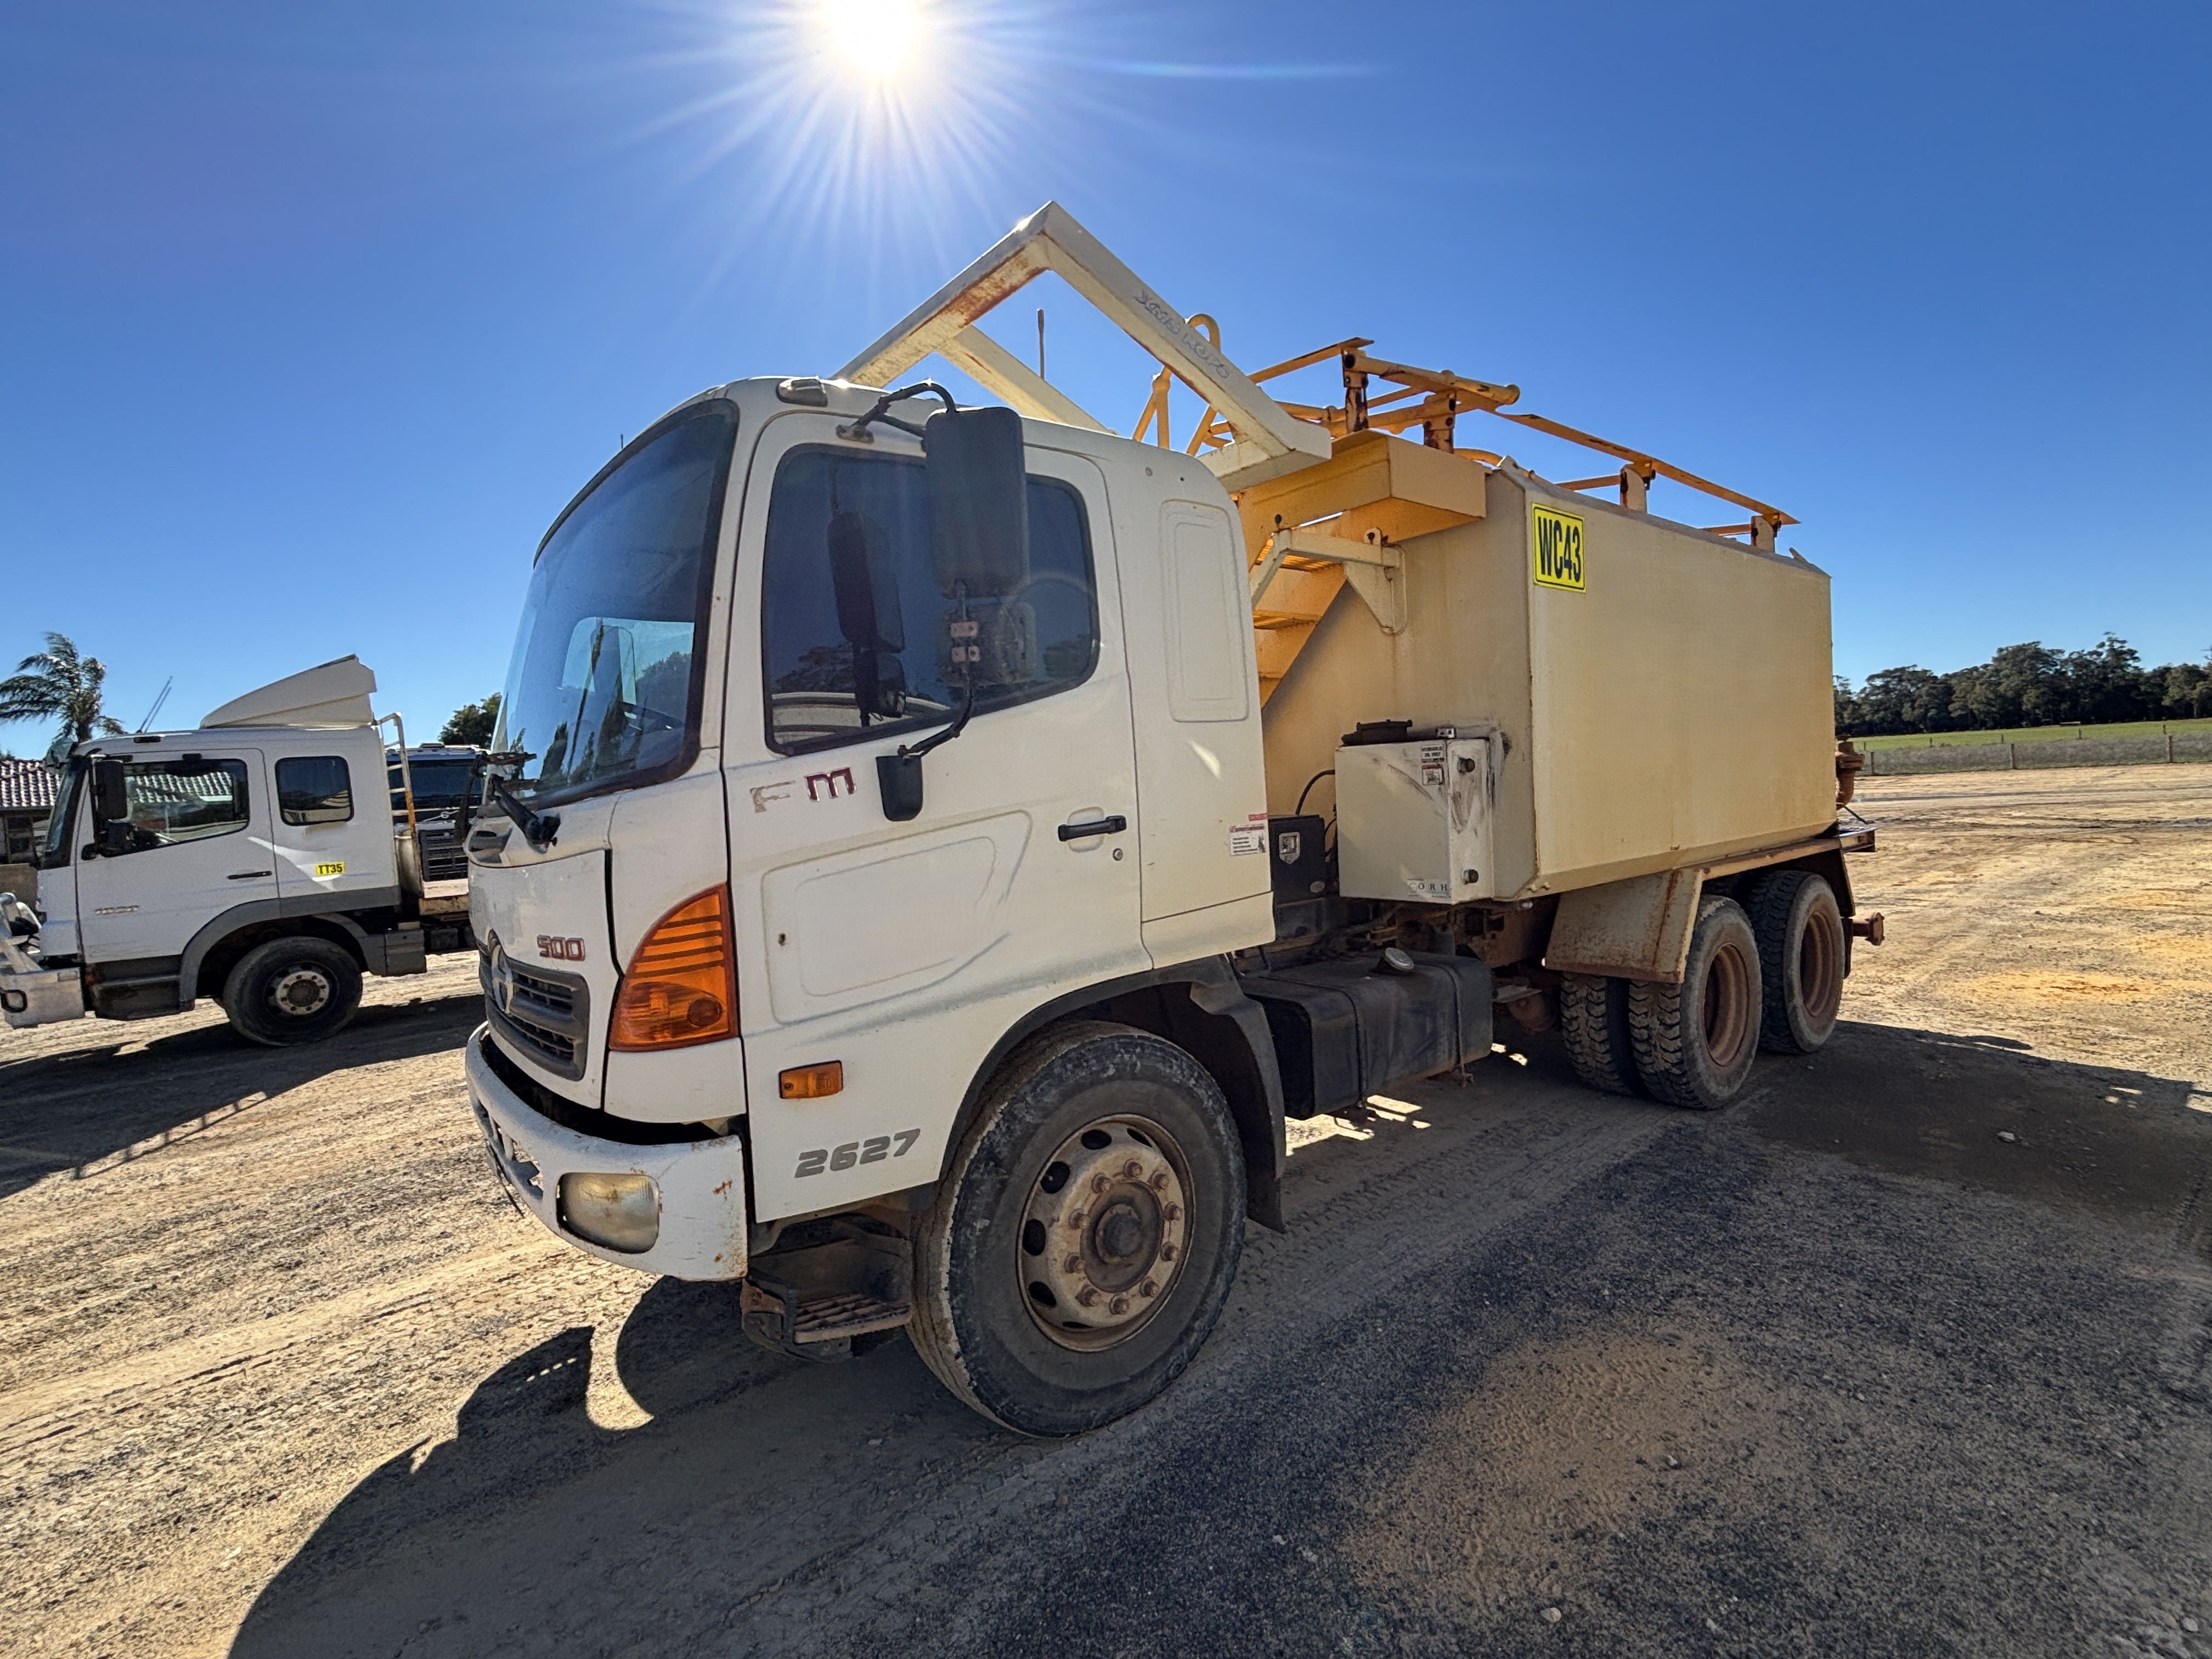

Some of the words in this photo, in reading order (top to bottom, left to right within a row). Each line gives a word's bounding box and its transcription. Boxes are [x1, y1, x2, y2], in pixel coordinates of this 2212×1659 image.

[1538, 516, 1582, 583] WC43
[318, 864, 343, 874] TT35
[537, 934, 586, 962] 500
[794, 1128, 921, 1178] 2627
